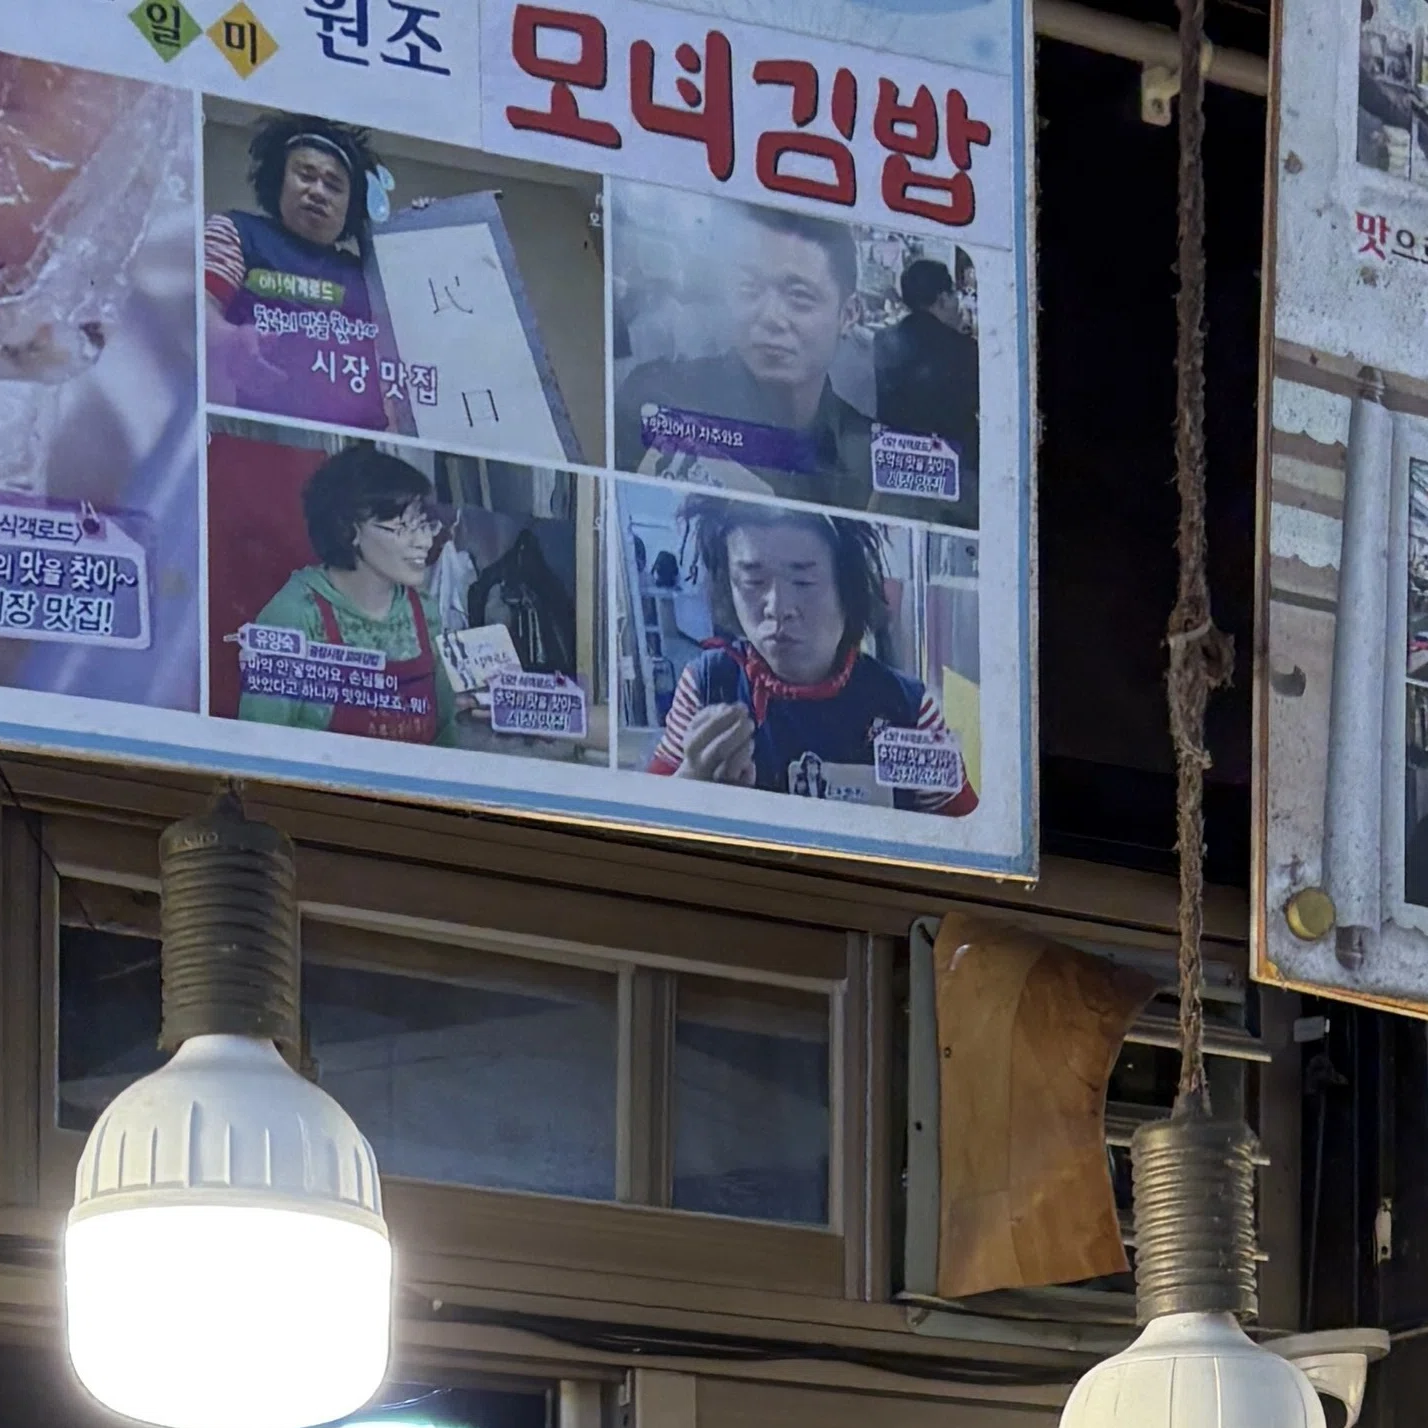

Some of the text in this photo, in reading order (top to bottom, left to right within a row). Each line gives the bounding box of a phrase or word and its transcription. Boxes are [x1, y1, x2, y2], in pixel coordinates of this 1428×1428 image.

[304, 0, 450, 76] 원조
[506, 3, 991, 227] 모녀김밥
[311, 350, 438, 407] 시장 맛집
[19, 550, 65, 587] 맛을
[43, 594, 116, 636] 맛집!
